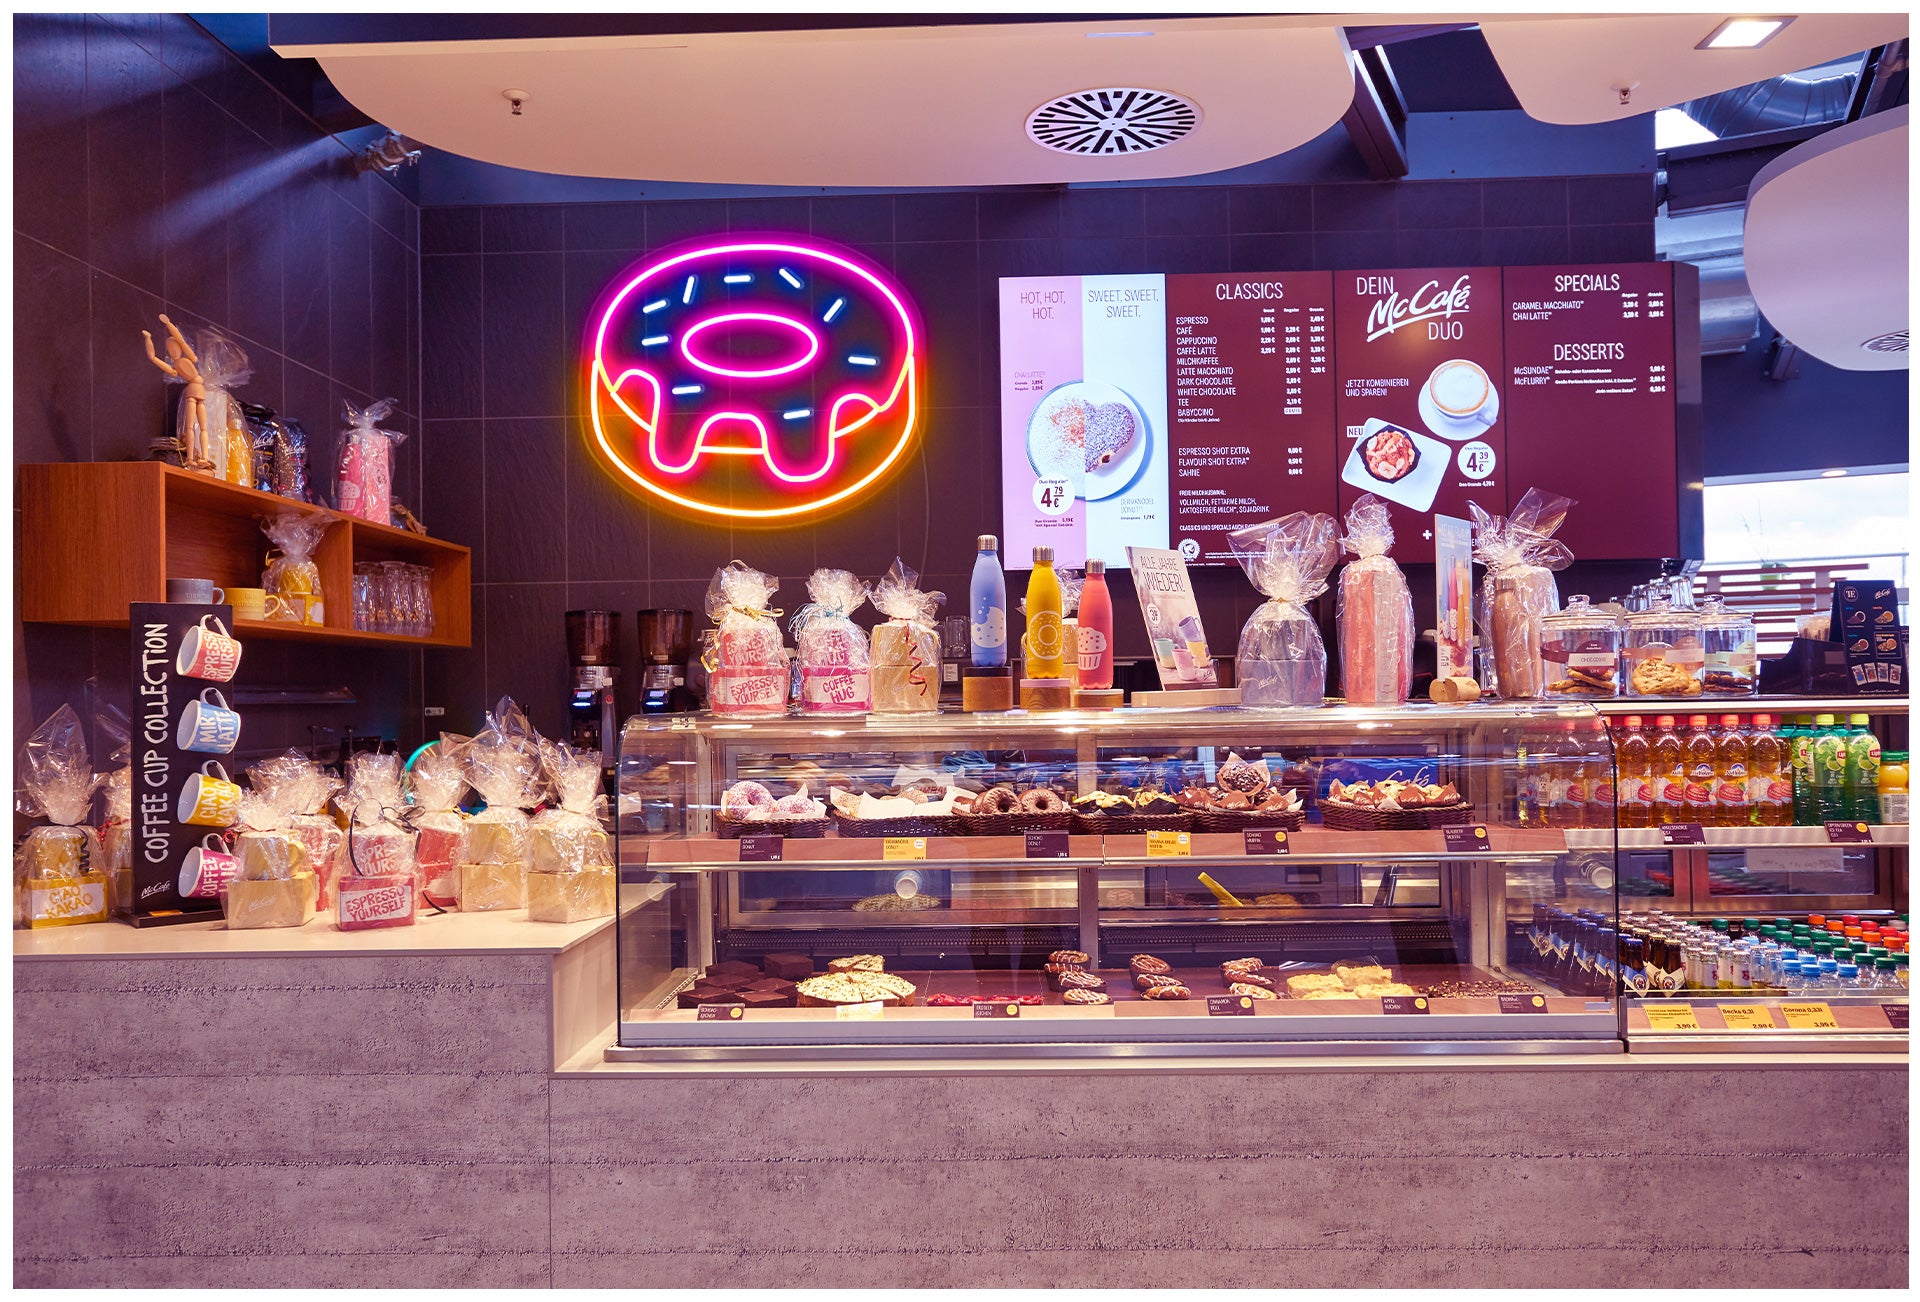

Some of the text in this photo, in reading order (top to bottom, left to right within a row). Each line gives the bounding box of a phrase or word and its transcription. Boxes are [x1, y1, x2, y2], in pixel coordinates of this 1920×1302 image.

[1357, 276, 1394, 295] DEIN
[1555, 274, 1620, 292] SPECIALS
[1021, 291, 1065, 305] HOT, HOT,
[1088, 289, 1159, 303] SWEET, SWEET,
[1216, 282, 1283, 300] CLASSICS
[1033, 307, 1054, 319] HOT.
[1107, 305, 1140, 318] SWEET.
[1367, 275, 1471, 342] McCafé
[1513, 302, 1542, 311] CARAMEL
[1176, 316, 1208, 324] ESPRESSO
[1513, 312, 1528, 321] CHAI
[1176, 326, 1192, 335] CAFÉ
[1428, 321, 1464, 340] DUO
[1176, 336, 1217, 345] CAPPUCCINO
[1197, 347, 1216, 355] LATTE
[1554, 343, 1624, 361] DESSERTS
[1177, 357, 1219, 365] MILCHKAFFEE
[1177, 367, 1233, 376] LATTE MACCHIATO
[1177, 377, 1232, 386] DARK CHOCOLATE
[1345, 378, 1408, 388] JETZT KOMBINIEREN
[1177, 387, 1236, 396] WHITE CHOCOLATE
[1346, 388, 1387, 397] UND SPAREN!
[1178, 408, 1214, 417] BABYCCINO
[1348, 427, 1363, 435] NEU
[1178, 447, 1250, 456] ESPRESSO SHOT EXTRA
[1178, 458, 1207, 467] FLAVOUR
[1208, 458, 1225, 466] SHOT
[1466, 452, 1477, 472] 4
[1178, 469, 1200, 477] SAHNE
[1041, 486, 1063, 508] 4 79
[1140, 556, 1179, 571] ALLE JAHRE
[1143, 571, 1186, 592] WIEDER!
[731, 675, 778, 697] ESPRESSO
[823, 675, 855, 693] COFFEE
[831, 687, 855, 703] HUG
[143, 749, 170, 787] CUP
[200, 786, 217, 819] CIAO
[141, 792, 170, 863] COFFEE
[201, 857, 218, 897] COFFEE
[345, 886, 405, 913] ESPRESSO
[349, 897, 406, 921] YOURSELF
